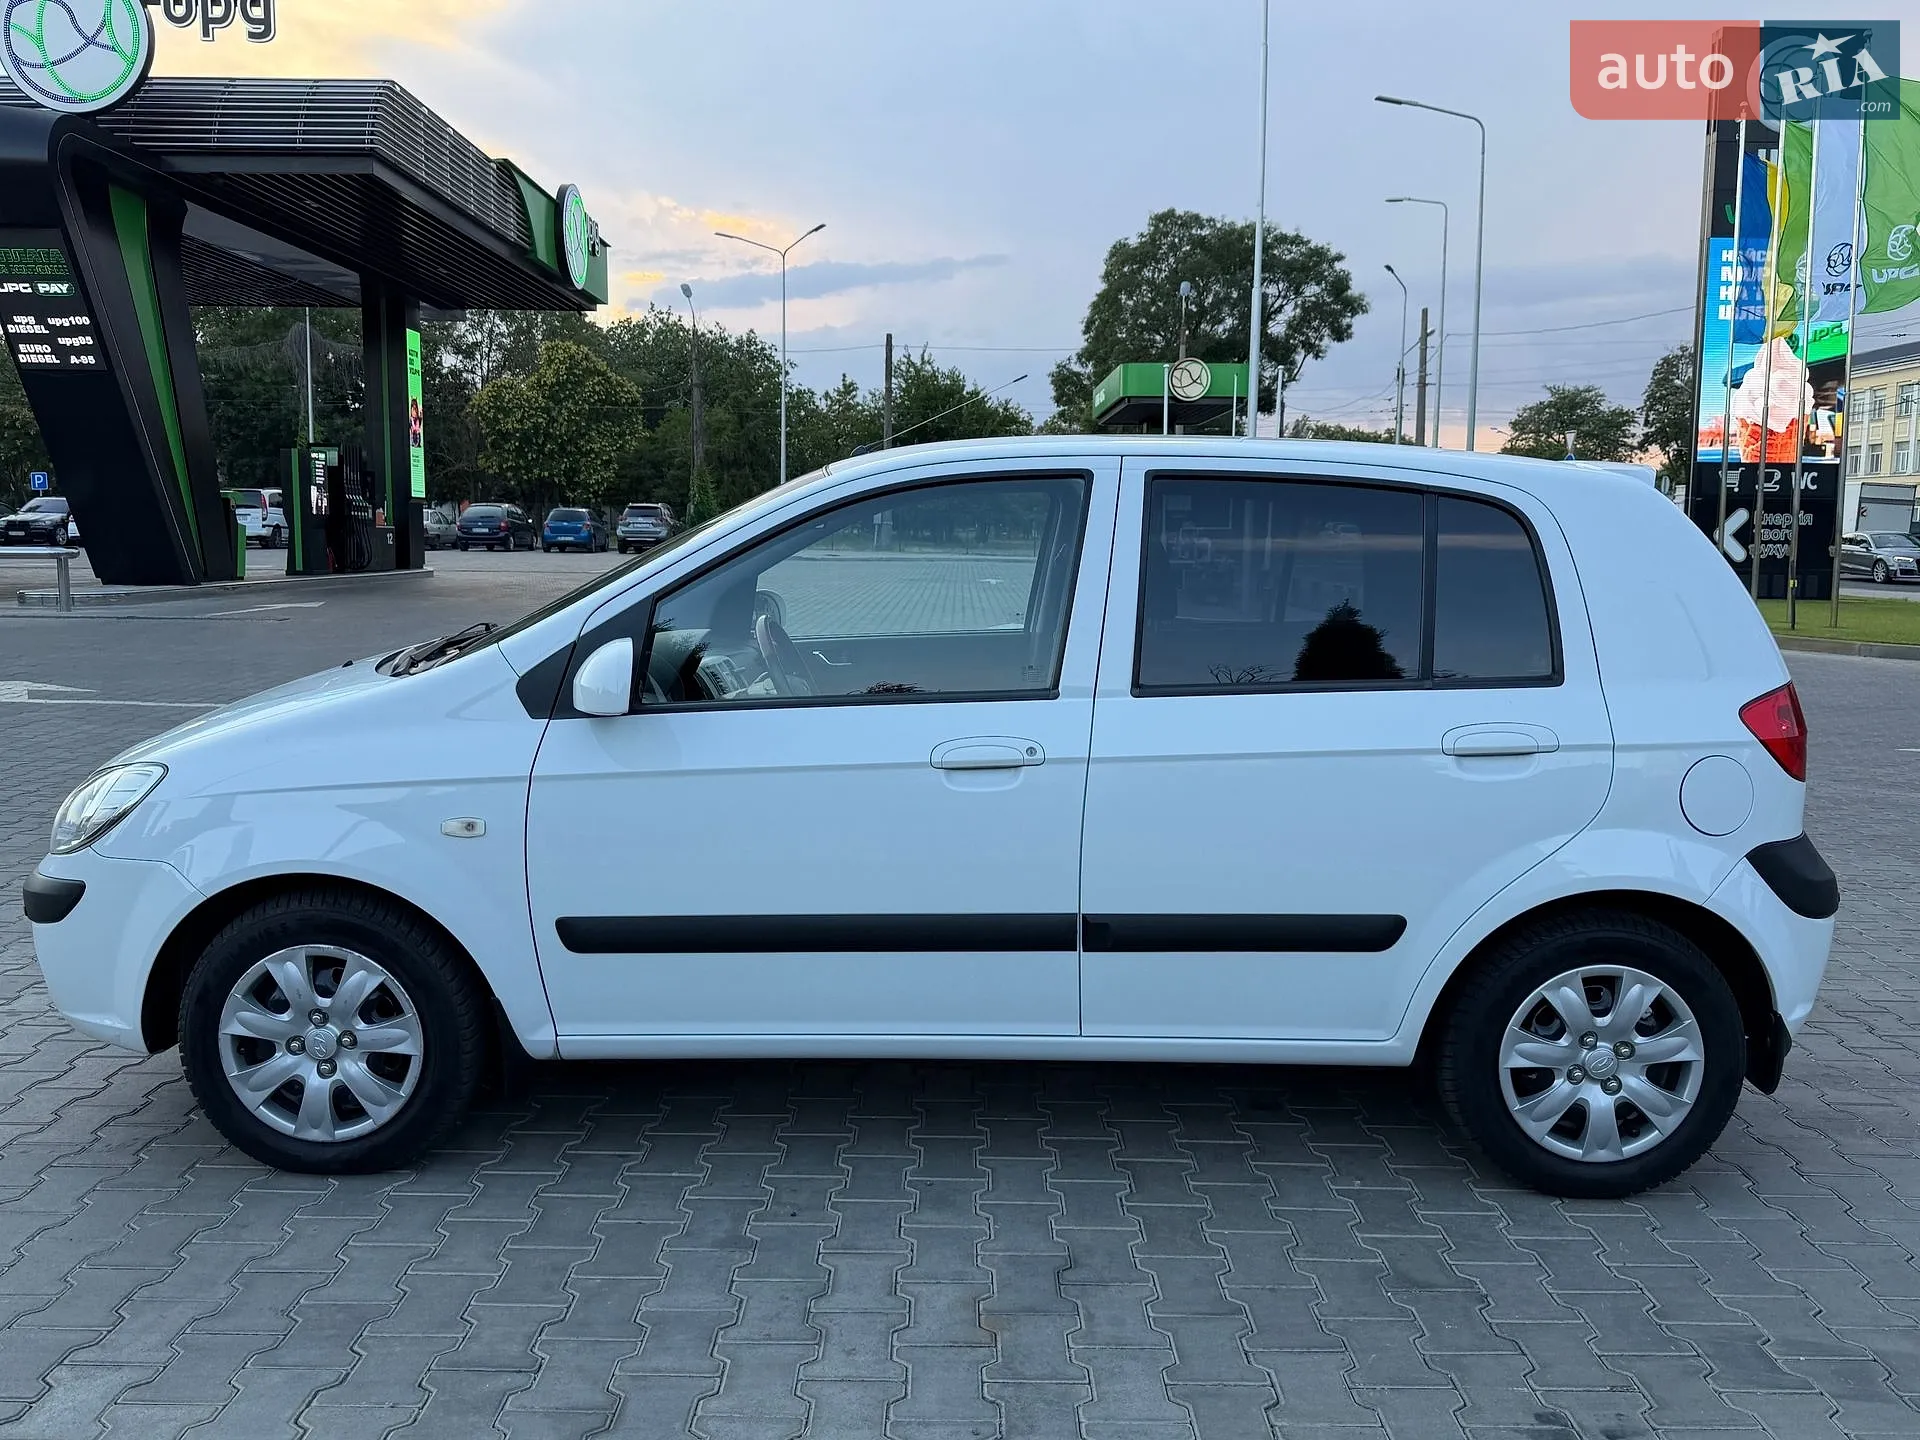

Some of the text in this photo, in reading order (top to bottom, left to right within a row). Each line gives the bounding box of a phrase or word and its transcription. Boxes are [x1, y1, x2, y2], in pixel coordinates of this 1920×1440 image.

[1871, 264, 1920, 284] UPG
[37, 283, 69, 293] PAY
[47, 316, 91, 327] upg100
[7, 324, 49, 334] DIESEL
[18, 344, 51, 353] EURO
[18, 354, 60, 364] DIESEL
[34, 474, 44, 488] P
